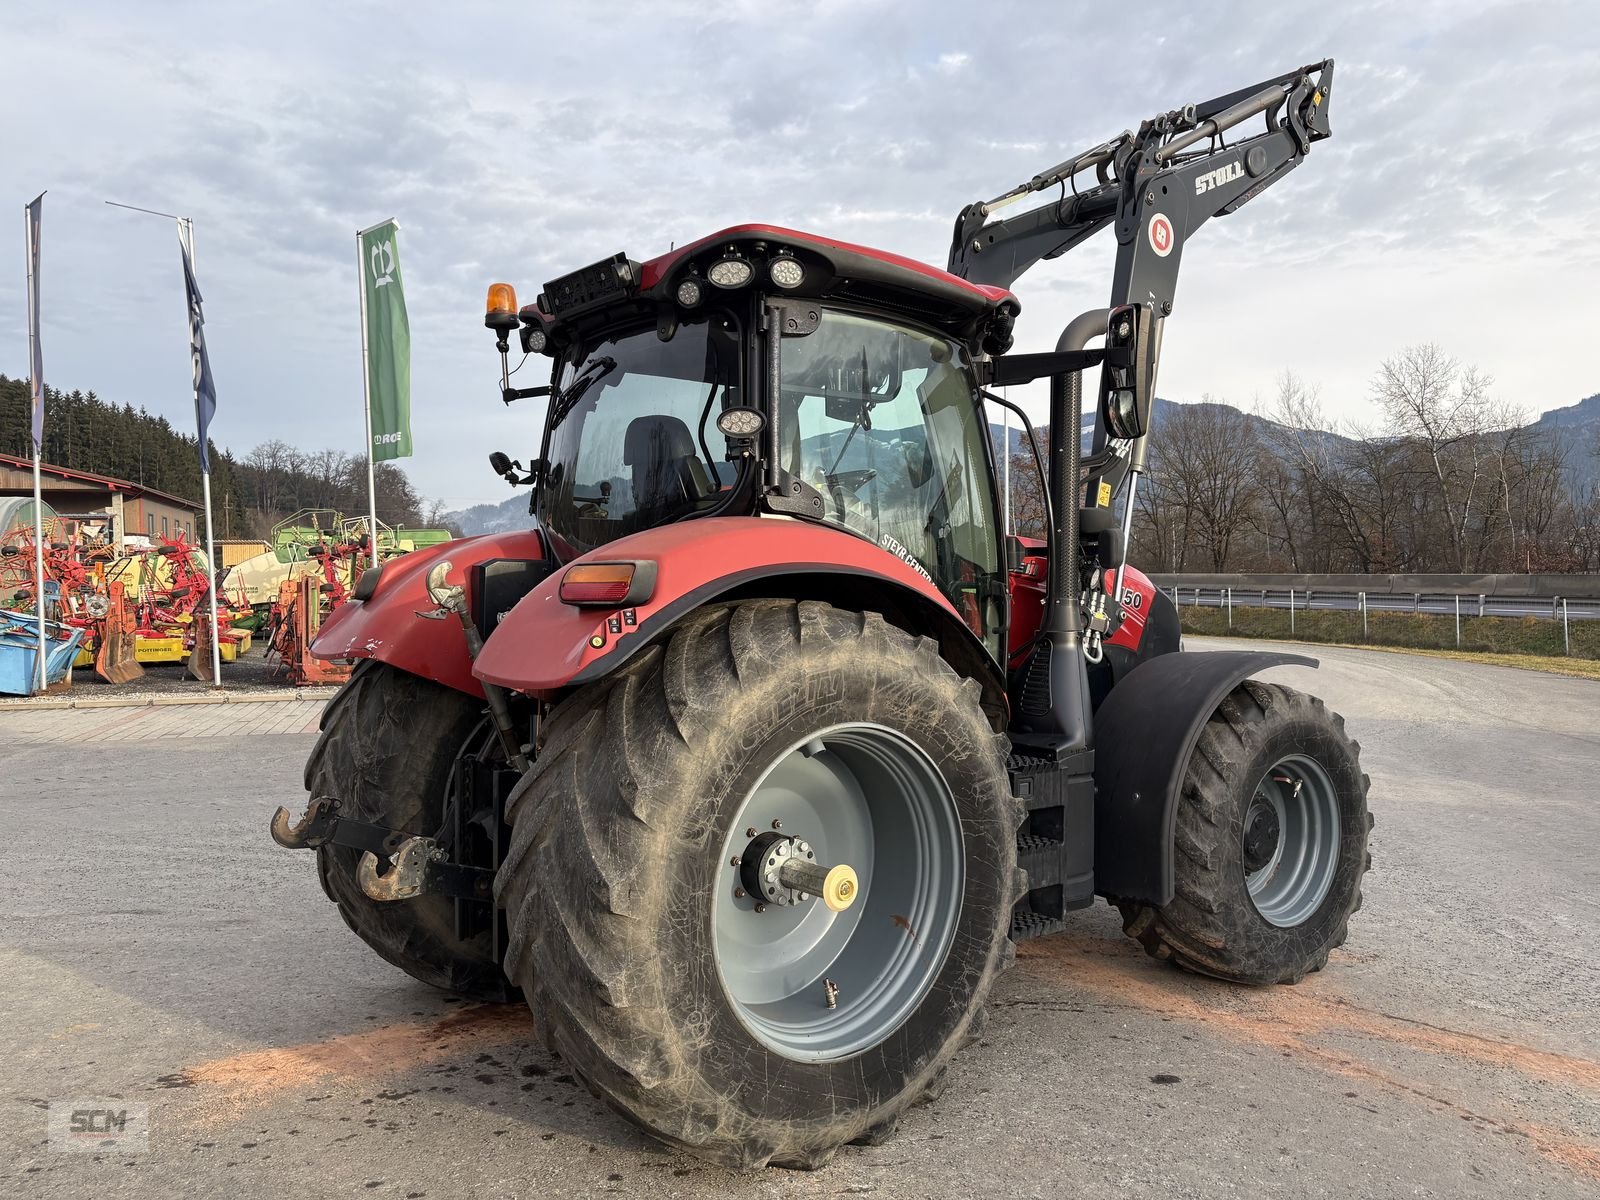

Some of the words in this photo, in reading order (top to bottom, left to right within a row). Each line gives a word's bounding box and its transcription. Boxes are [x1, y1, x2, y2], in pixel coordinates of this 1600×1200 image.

[1195, 161, 1245, 196] STOLL
[881, 534, 907, 560] STEYR
[1121, 586, 1143, 611] 50
